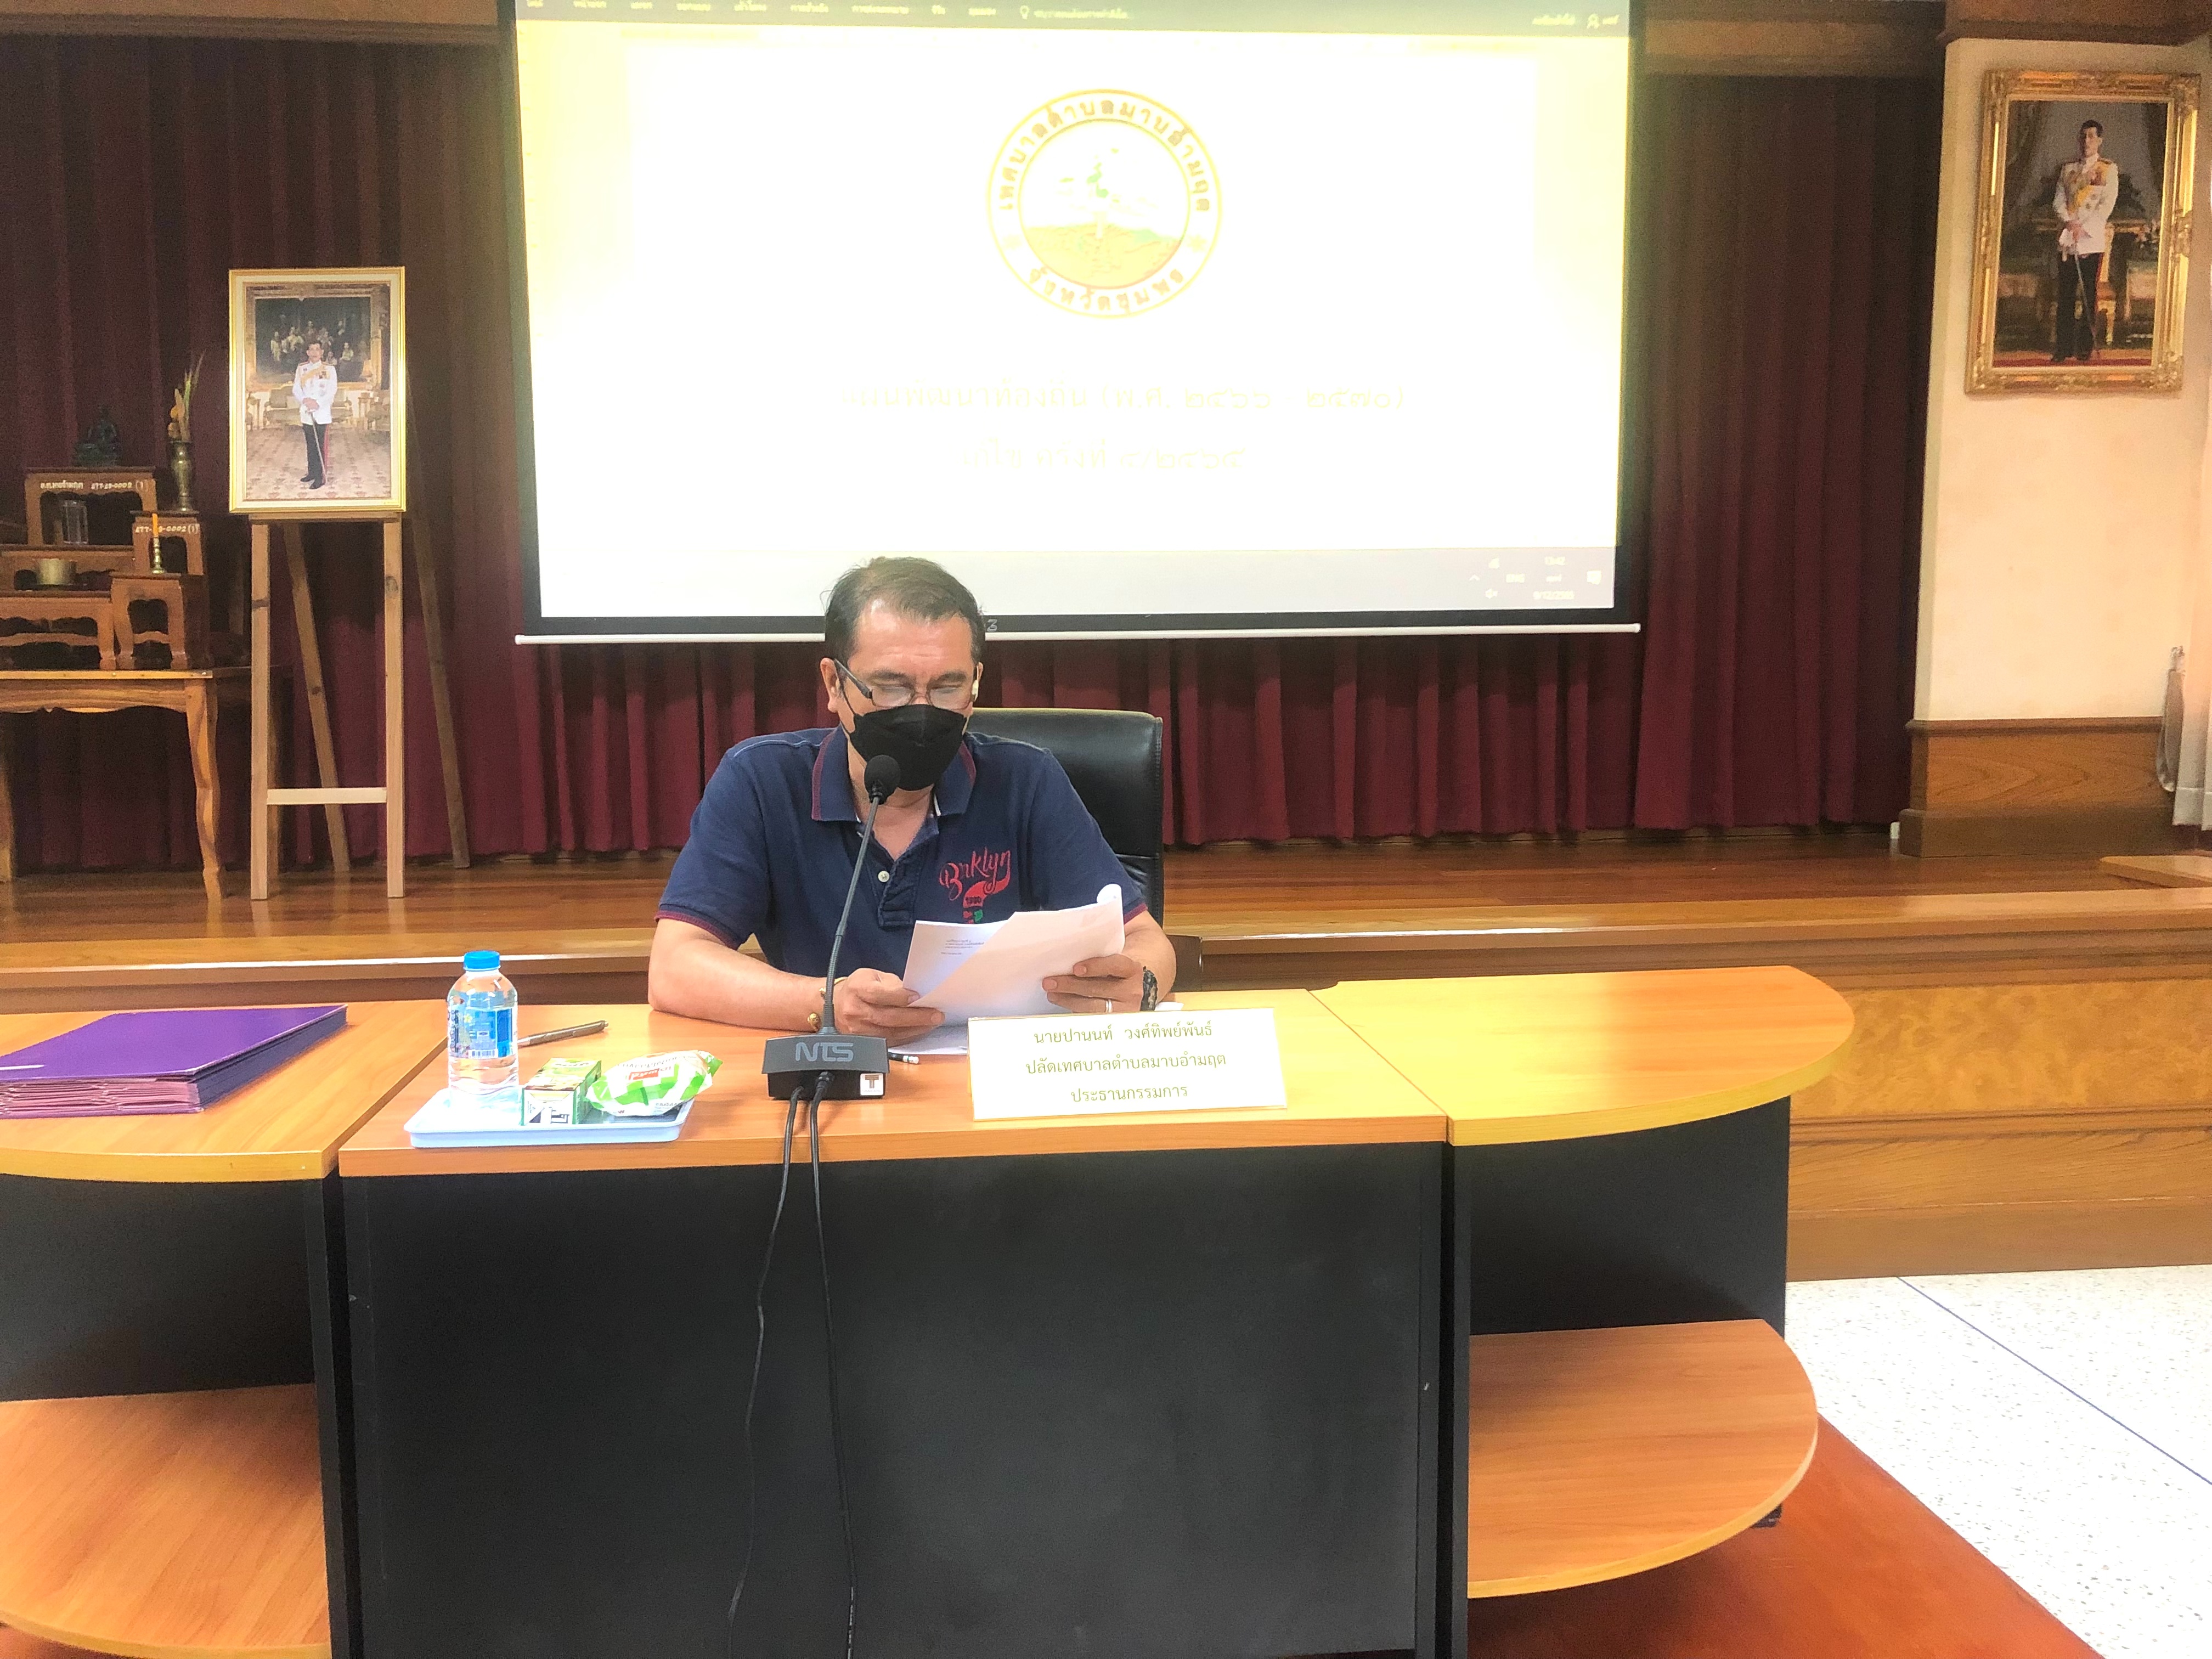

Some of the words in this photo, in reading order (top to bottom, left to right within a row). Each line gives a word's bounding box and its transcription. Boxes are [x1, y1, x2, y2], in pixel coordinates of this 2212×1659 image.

[1034, 1024, 1113, 1043] นายปานนท์
[1125, 1020, 1212, 1039] วงศ์ทิพย์พันธ์
[795, 1041, 854, 1062] NTS
[1026, 1052, 1226, 1074] ปลัดเทศบาลตำบลมาบอำมฤต
[1071, 1085, 1188, 1102] ประธานกรรมการ
